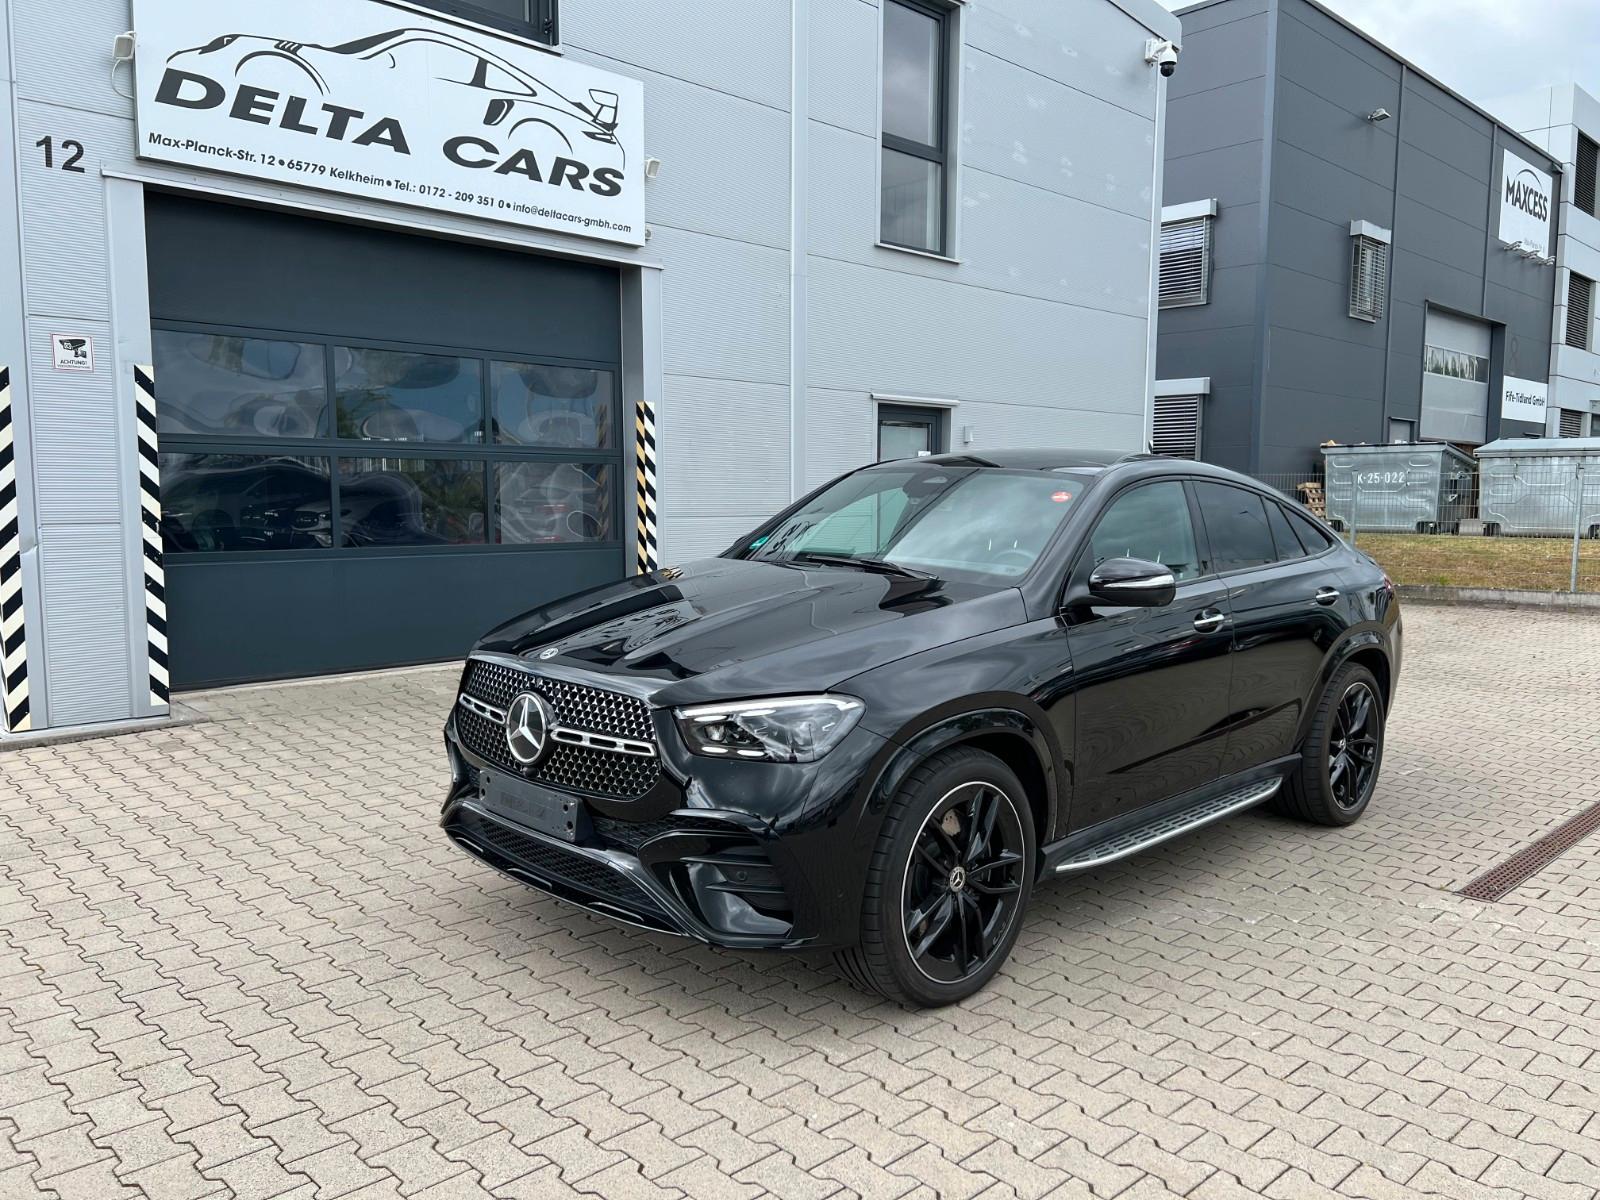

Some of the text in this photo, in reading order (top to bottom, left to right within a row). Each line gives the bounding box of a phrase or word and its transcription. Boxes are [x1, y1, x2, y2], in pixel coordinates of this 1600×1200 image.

[36, 136, 86, 173] 12
[154, 67, 625, 197] DELTA CARS
[148, 132, 257, 163] Max-Planck-Str.
[260, 153, 276, 166] 12
[286, 159, 326, 175] 65779
[329, 167, 385, 187] Kelkheim
[394, 179, 416, 193] Tel.:
[418, 184, 446, 198] 0172
[454, 191, 475, 203] 209
[476, 195, 495, 208] 351
[497, 199, 505, 209] 0
[512, 202, 631, 233] info@deltacars-gmbh.com
[1505, 175, 1548, 223] MAXCESS
[1357, 471, 1406, 484] K-25-022
